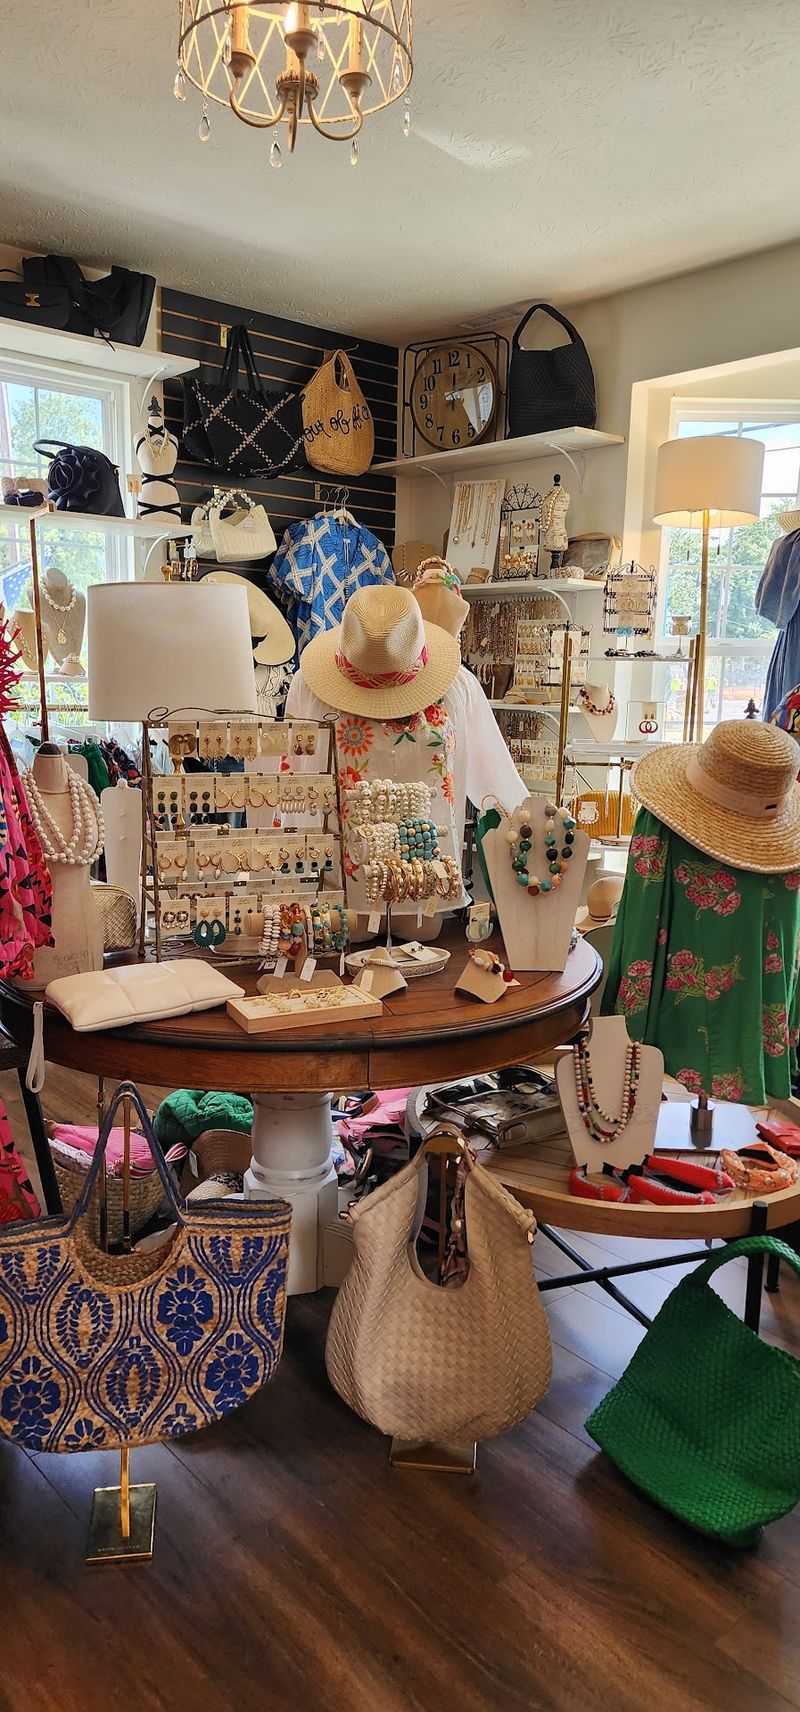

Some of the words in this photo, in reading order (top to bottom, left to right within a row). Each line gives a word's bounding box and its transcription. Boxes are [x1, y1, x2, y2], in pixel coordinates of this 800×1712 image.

[448, 350, 460, 367] 12
[466, 353, 471, 369] 1
[432, 359, 441, 375] 11
[476, 367, 485, 383] 2
[423, 375, 436, 392] 10
[420, 393, 428, 409] 9
[330, 409, 351, 435] of
[425, 413, 434, 429] 8
[436, 426, 444, 442] 7
[451, 430, 461, 445] 6
[467, 422, 476, 438] 5
